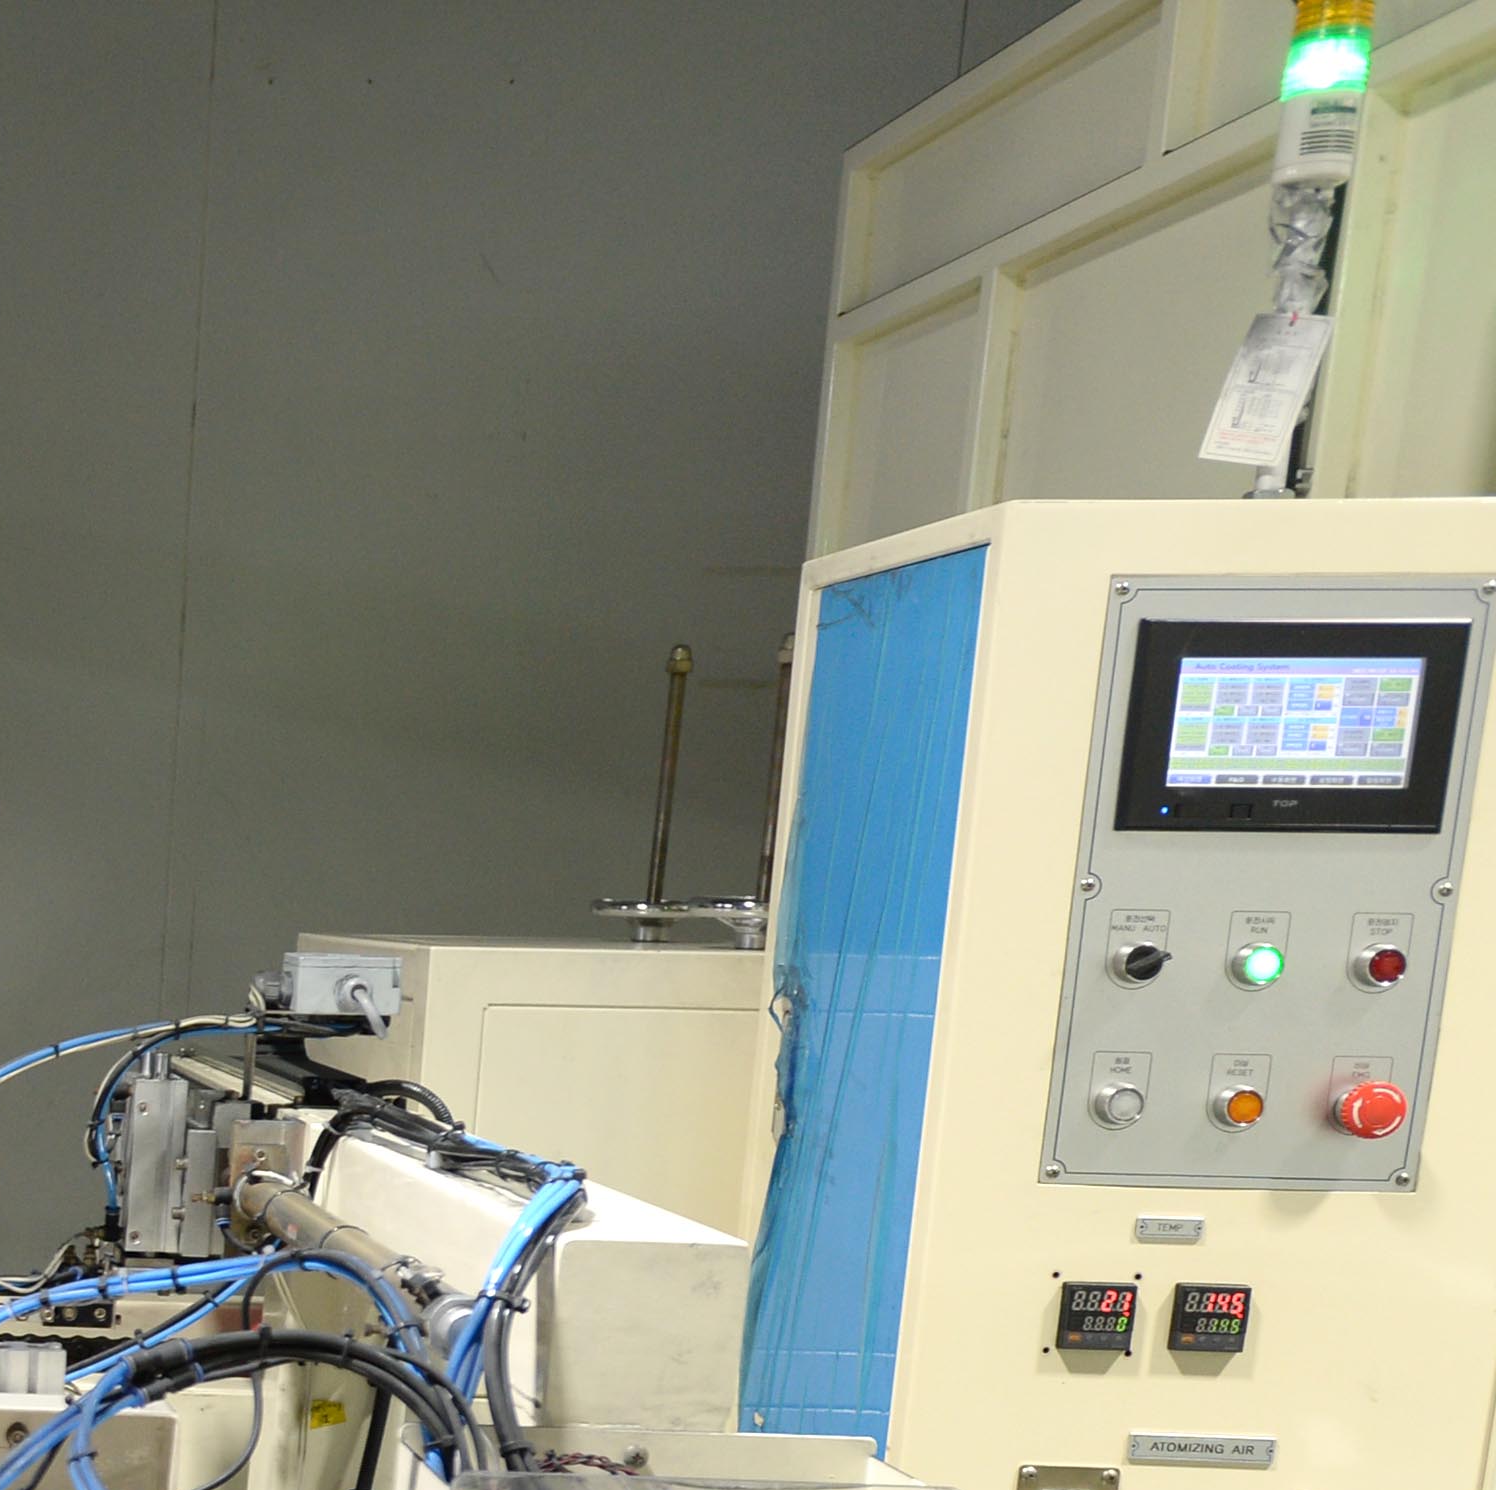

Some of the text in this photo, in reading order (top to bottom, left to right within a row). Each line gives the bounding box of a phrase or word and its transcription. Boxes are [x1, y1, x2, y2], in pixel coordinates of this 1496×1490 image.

[1195, 662, 1290, 672] Auto Coating System
[1143, 924, 1167, 933] AUTO
[1250, 926, 1268, 935] RUN
[1370, 927, 1393, 937] STOP
[1110, 1065, 1132, 1075] HOME
[1226, 1068, 1254, 1078] RESET
[1157, 1223, 1184, 1233] TEMP
[1150, 1441, 1255, 1456] ATOMIZING AIR
